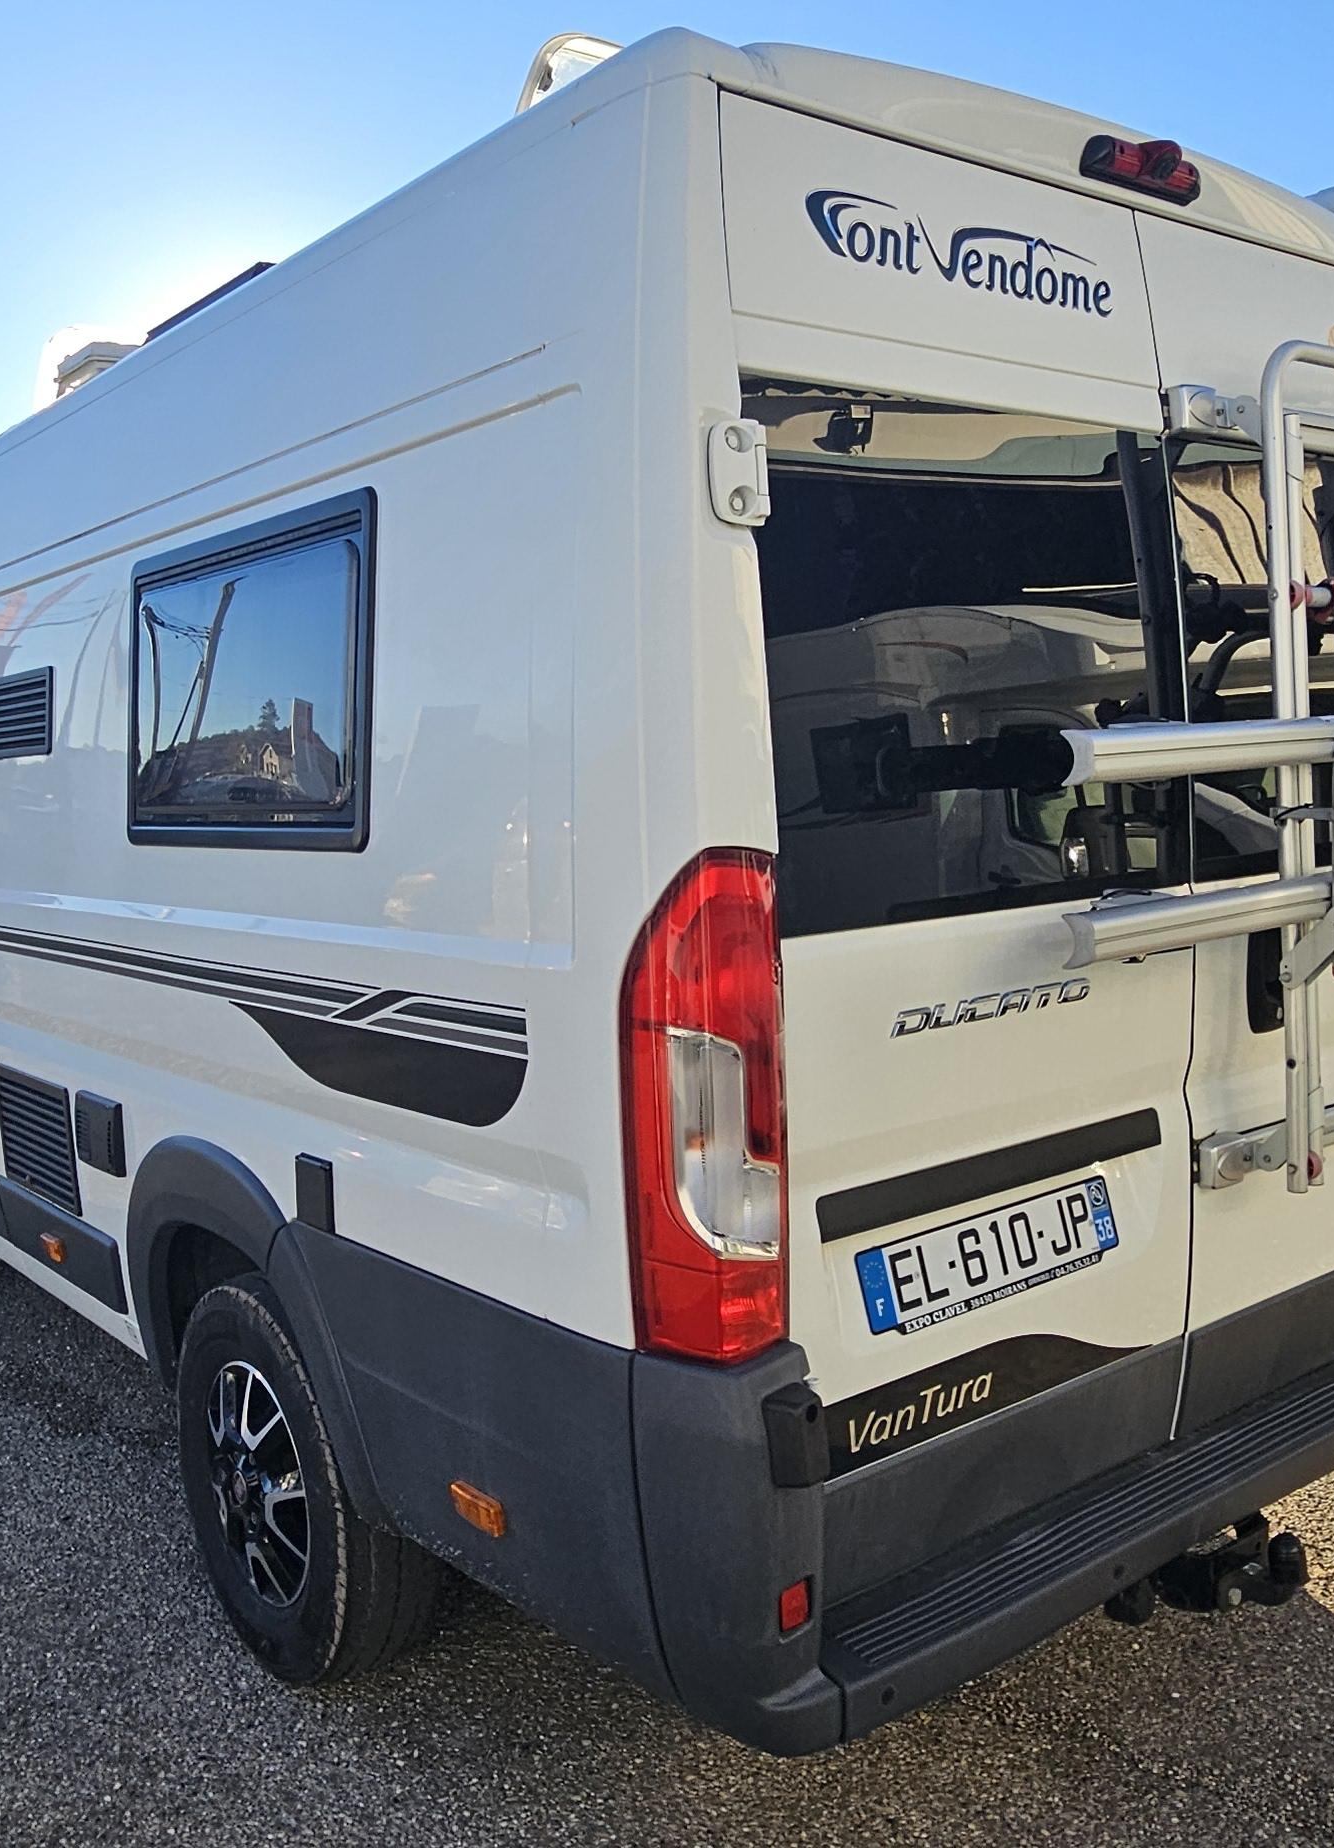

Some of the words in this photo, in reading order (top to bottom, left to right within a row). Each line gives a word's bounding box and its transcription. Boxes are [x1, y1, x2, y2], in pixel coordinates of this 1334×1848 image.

[890, 977, 1091, 1040] DUCATO
[888, 1192, 1089, 1313] EL-610-JP
[1095, 1215, 1115, 1242] 38
[875, 1298, 885, 1317] F
[905, 1315, 932, 1334] EXPO
[932, 1301, 968, 1323] CLAVEL
[993, 1280, 1028, 1301] MOIRANS
[849, 1371, 994, 1454] VanTura
